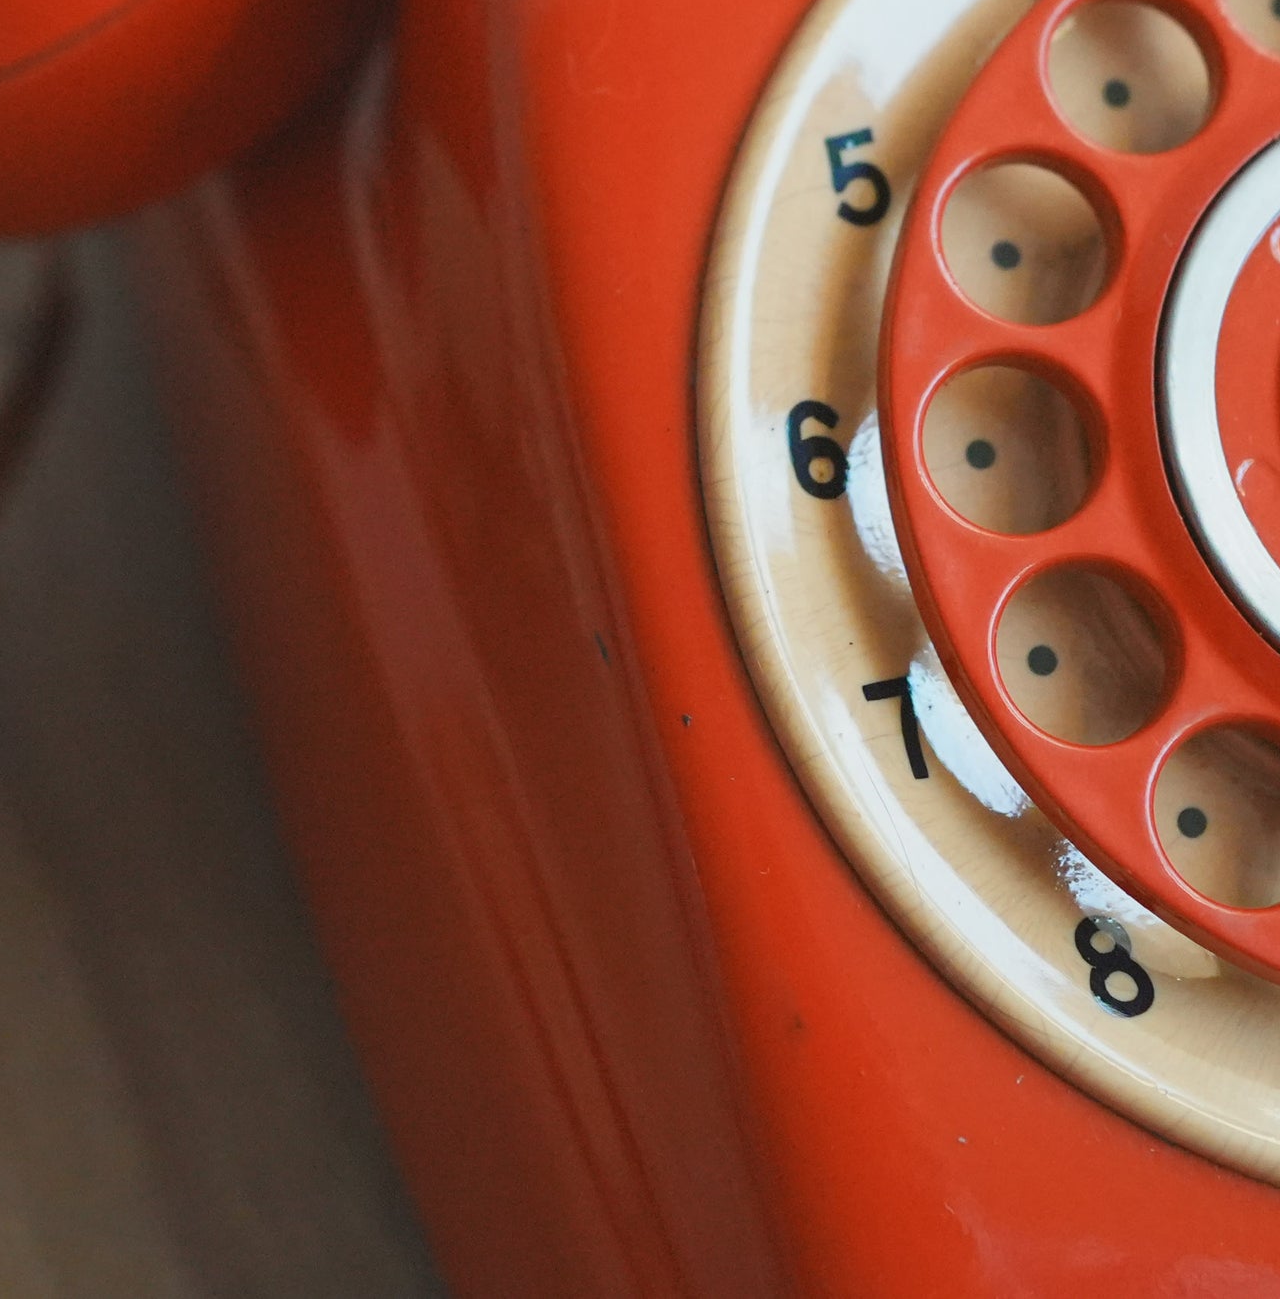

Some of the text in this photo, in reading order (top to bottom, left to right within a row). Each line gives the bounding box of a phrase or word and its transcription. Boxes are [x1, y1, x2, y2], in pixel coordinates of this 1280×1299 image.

[823, 128, 892, 227] 5
[788, 399, 851, 499] 6
[861, 675, 929, 779] 7
[1074, 915, 1155, 1018] 8
